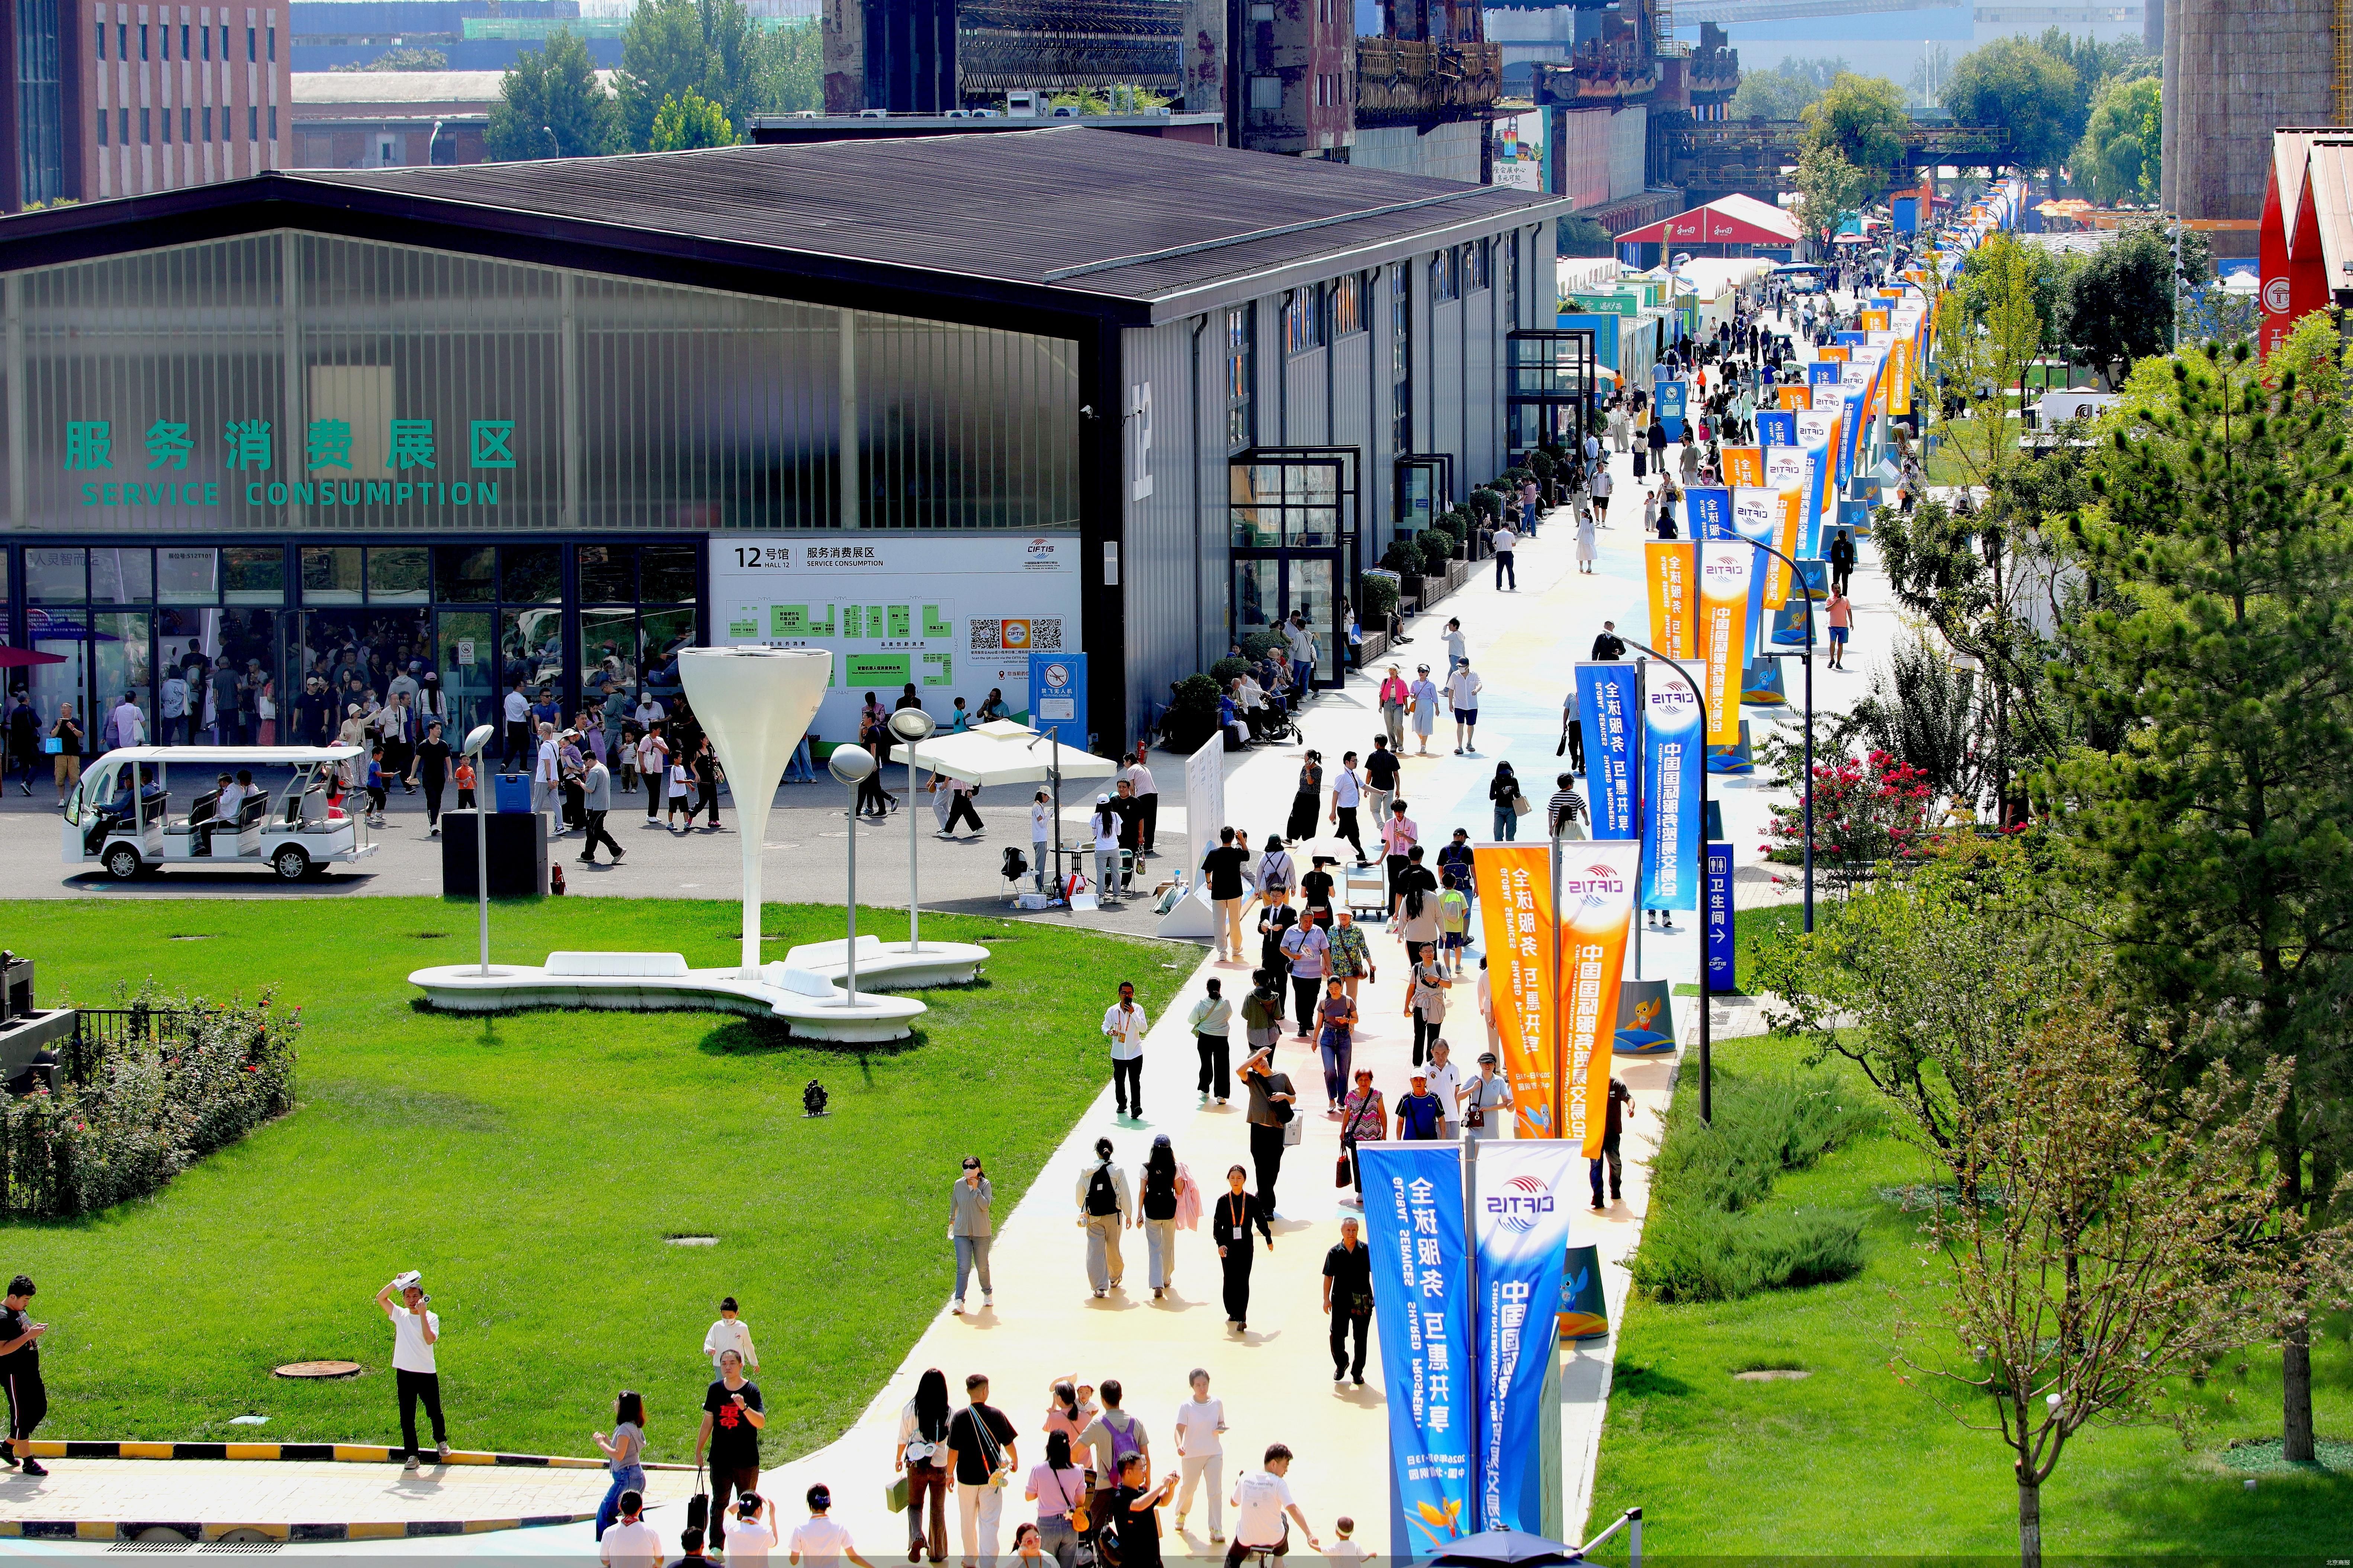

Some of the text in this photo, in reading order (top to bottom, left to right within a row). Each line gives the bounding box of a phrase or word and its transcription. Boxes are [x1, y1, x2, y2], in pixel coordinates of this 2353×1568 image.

[64, 419, 517, 471] 服务消费展区
[82, 482, 499, 506] SERVICE CONSUMPTION
[735, 547, 762, 567] 12
[765, 548, 789, 560] 号馆
[807, 547, 875, 558] 服务消费展区
[1711, 879, 1724, 925] 卫生间
